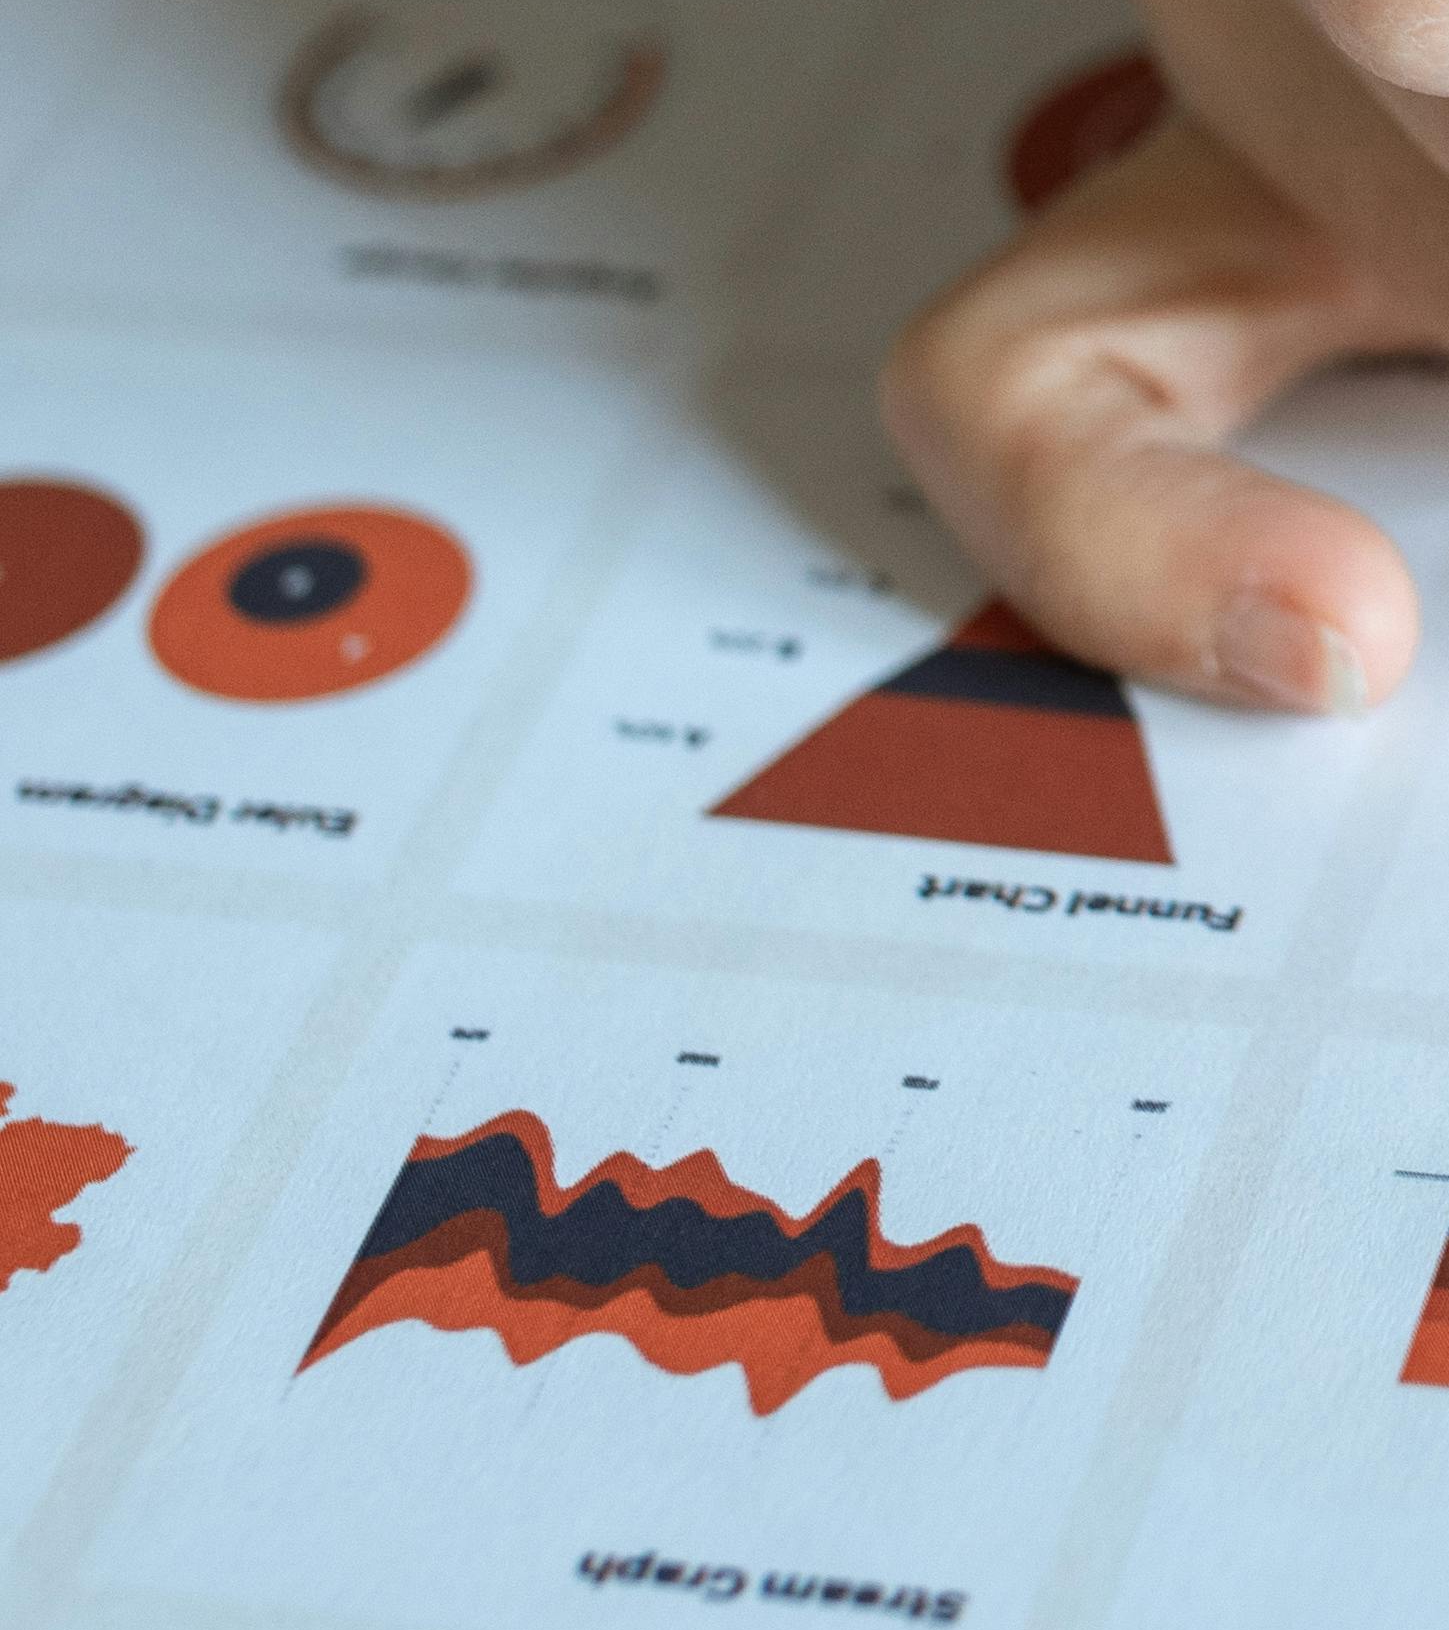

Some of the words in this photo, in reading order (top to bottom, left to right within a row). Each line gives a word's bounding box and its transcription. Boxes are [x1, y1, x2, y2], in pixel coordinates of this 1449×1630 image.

[18, 784, 220, 822] Diagram
[235, 804, 356, 836] Euler
[919, 877, 1057, 912] Chart
[1067, 892, 1241, 931] Funnel
[579, 1554, 746, 1599] Graph
[762, 1575, 961, 1623] Stream
